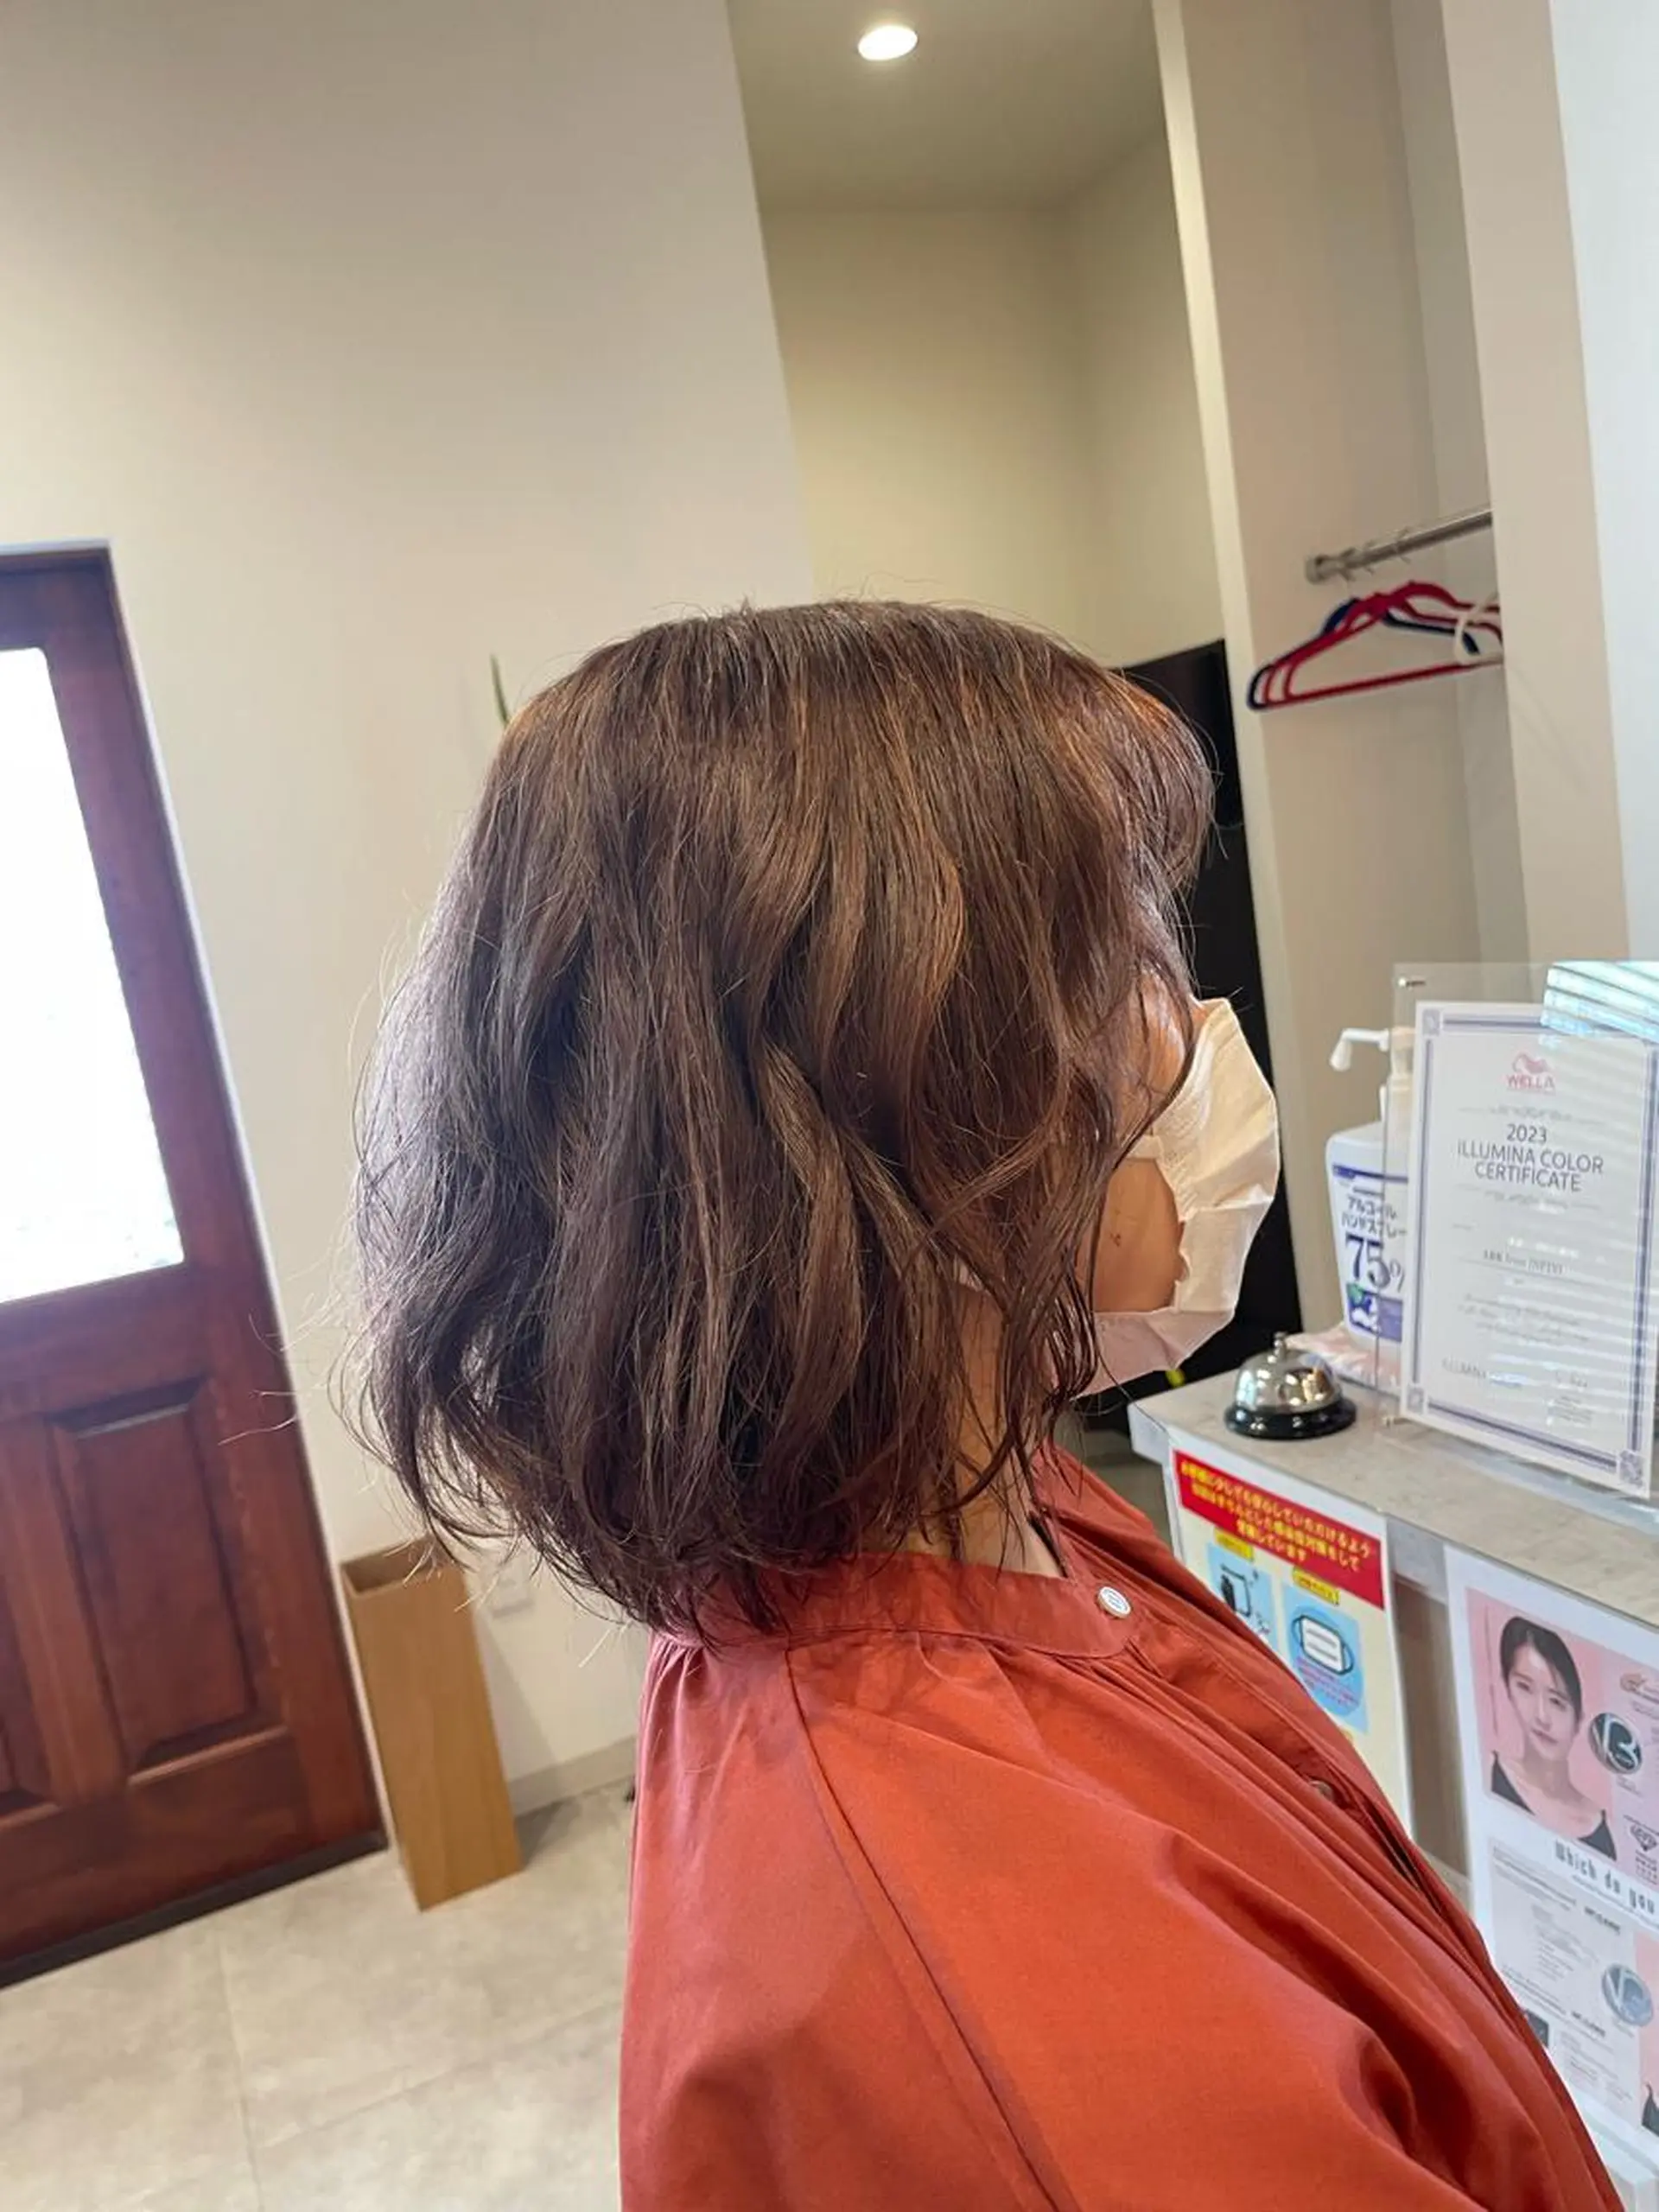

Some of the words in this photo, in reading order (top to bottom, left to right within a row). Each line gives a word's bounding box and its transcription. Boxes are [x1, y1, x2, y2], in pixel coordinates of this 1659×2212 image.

[1506, 1074, 1555, 1090] WELLA
[1507, 1123, 1548, 1143] 2023
[1458, 1139, 1535, 1165] ILLUMINA
[1540, 1148, 1604, 1174] COLOR
[1475, 1161, 1581, 1192] CERTIFICATE
[1555, 1840, 1597, 1880] Which
